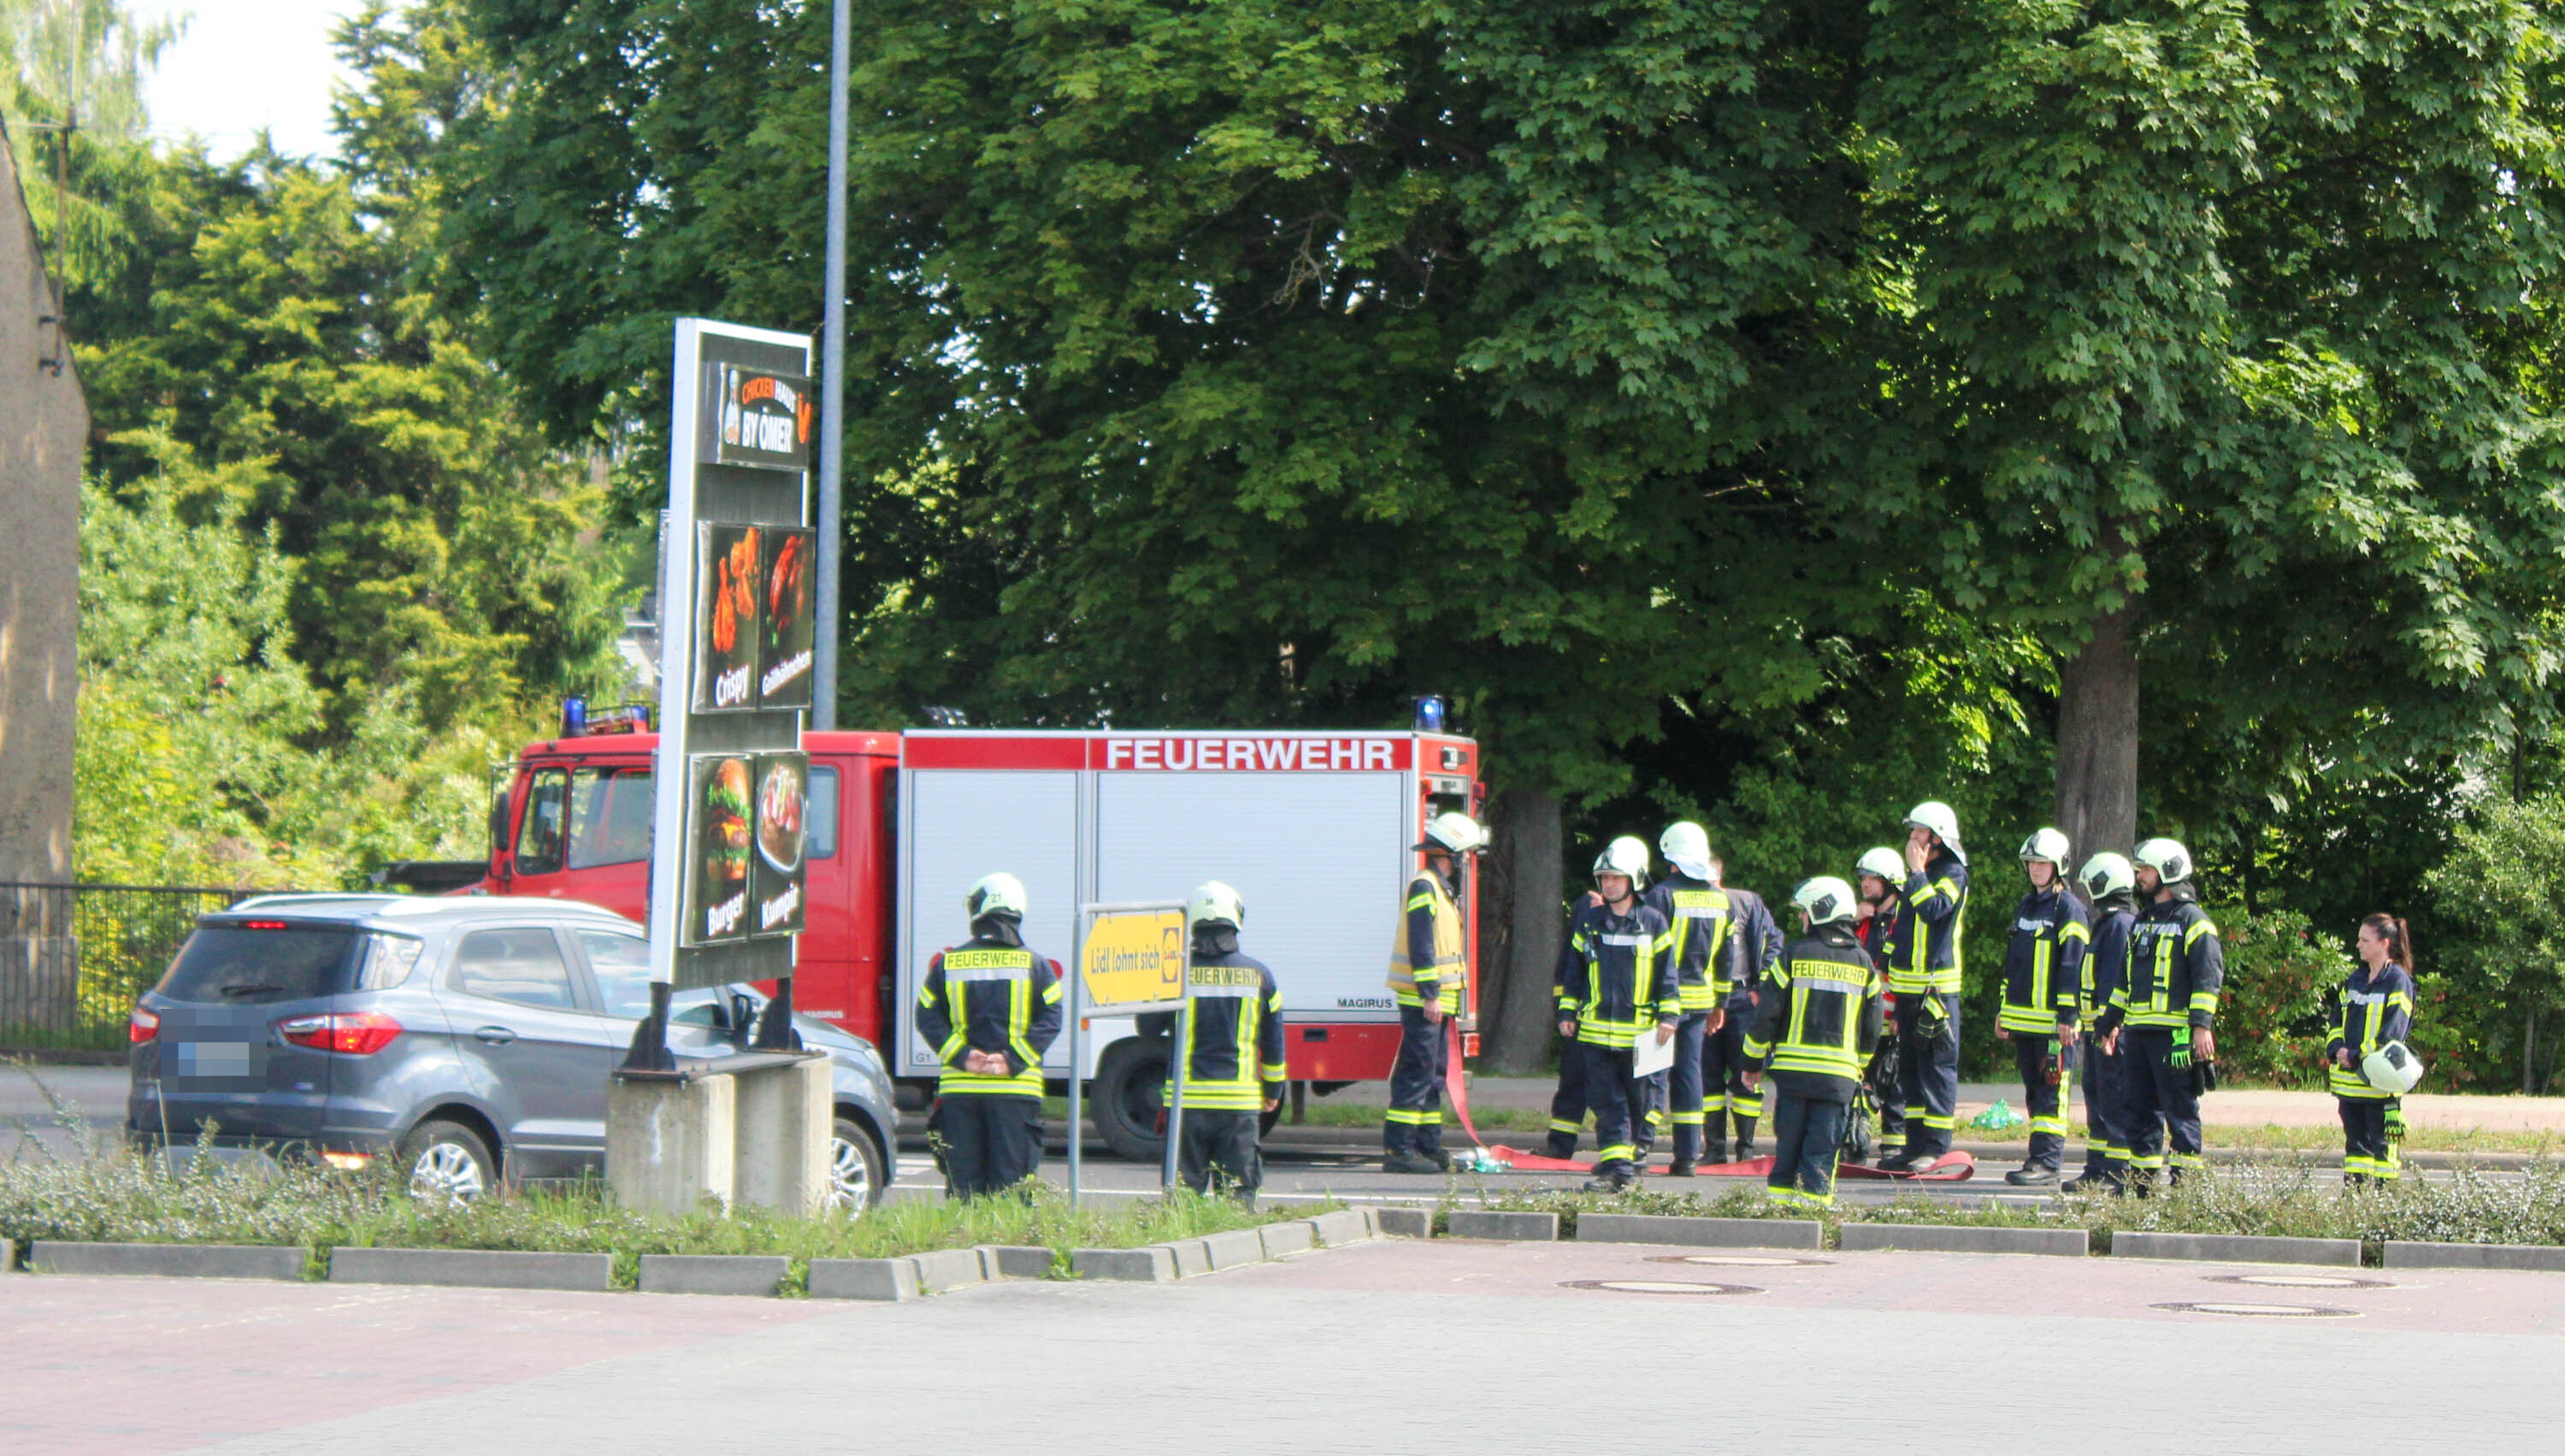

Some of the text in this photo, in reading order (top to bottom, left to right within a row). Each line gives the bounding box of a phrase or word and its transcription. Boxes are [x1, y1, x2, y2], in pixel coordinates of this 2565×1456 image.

[742, 405, 793, 453] BY ÖMER
[715, 663, 750, 706] Crispy
[1106, 740, 1394, 769] FEUERWEHR
[762, 881, 799, 930] Kumpir
[991, 893, 1002, 903] 21
[707, 891, 746, 937] Burger
[947, 952, 1028, 968] FEUERWEHR
[1091, 944, 1159, 974] Lidl lohnt sich
[1189, 968, 1260, 986] EUERWEHR
[1794, 962, 1866, 984] FEUERWEHR
[1336, 998, 1393, 1009] MAGIRUS
[916, 1052, 930, 1063] G1
